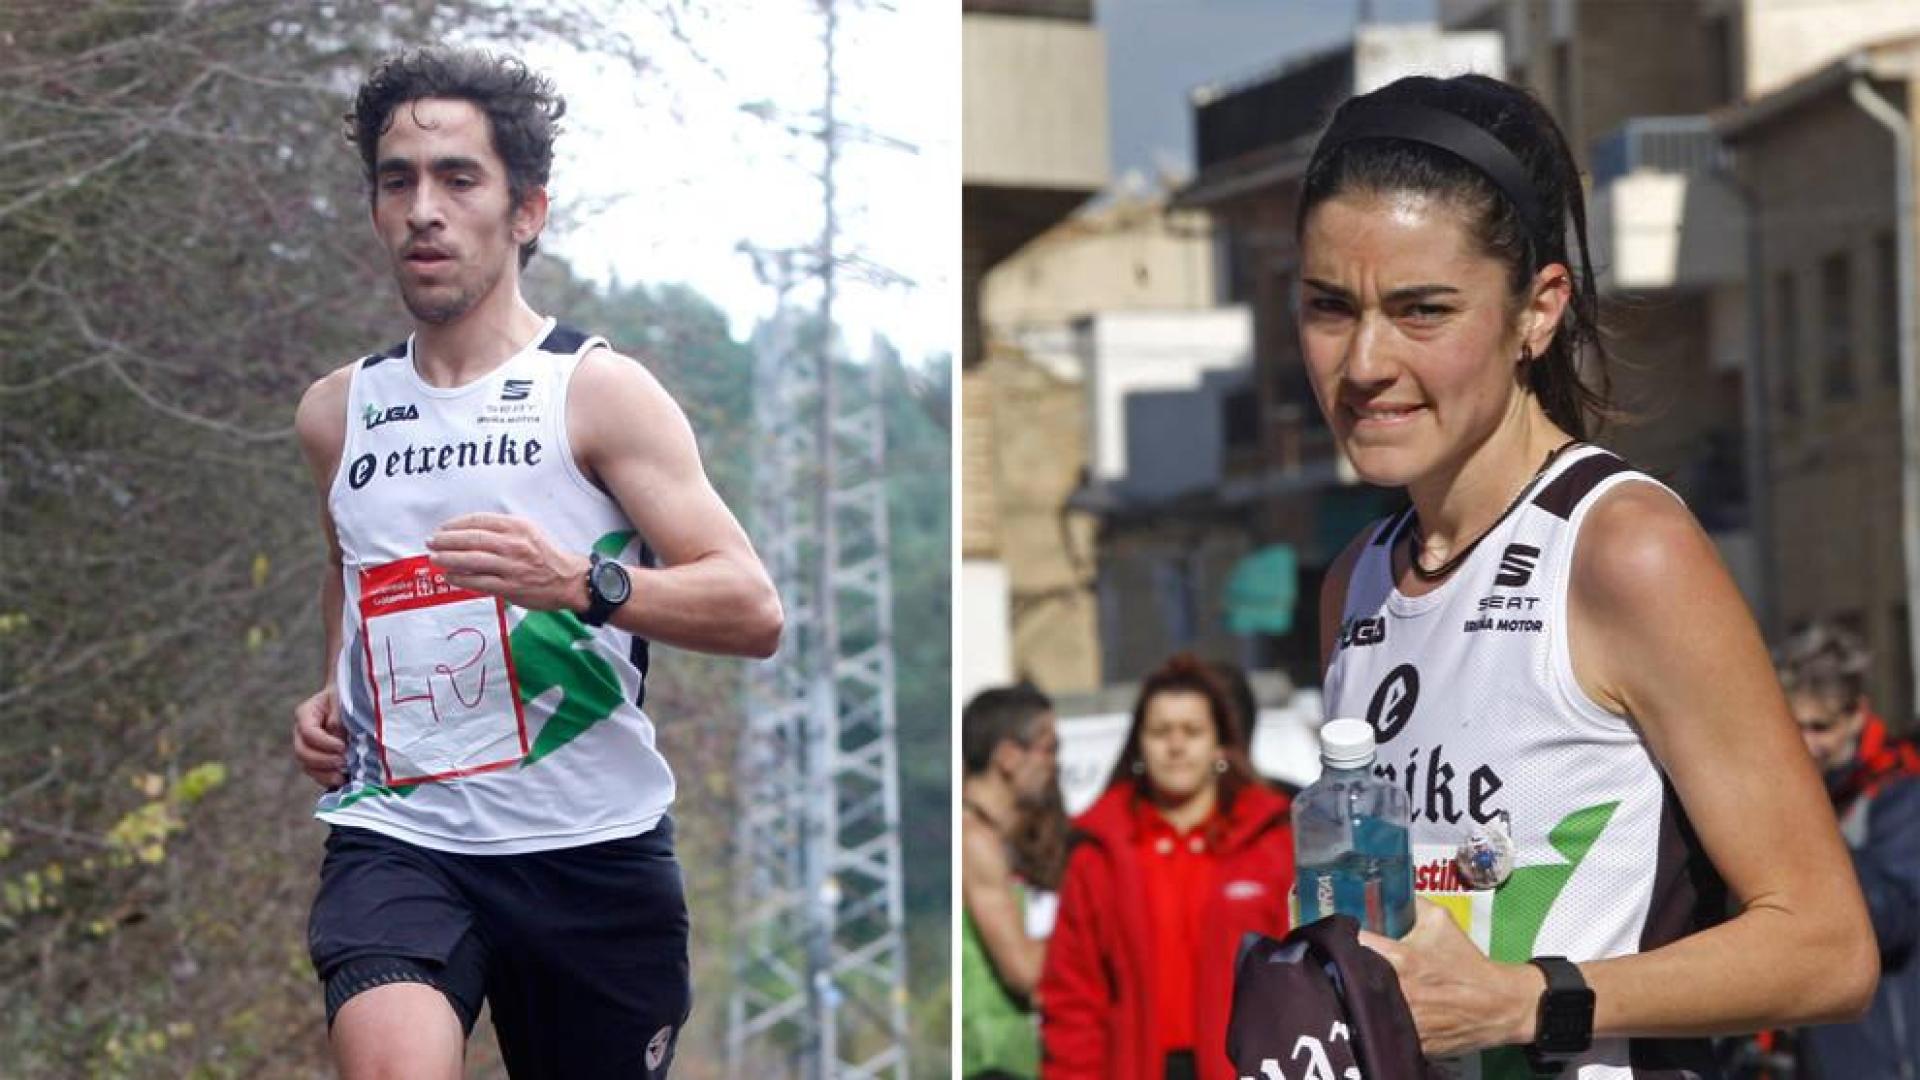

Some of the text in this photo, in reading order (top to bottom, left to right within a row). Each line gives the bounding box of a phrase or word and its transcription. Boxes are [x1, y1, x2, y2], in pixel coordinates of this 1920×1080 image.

[385, 434, 542, 477] etxenike
[1478, 595, 1540, 611] SEAT
[1496, 619, 1543, 632] MOTOR
